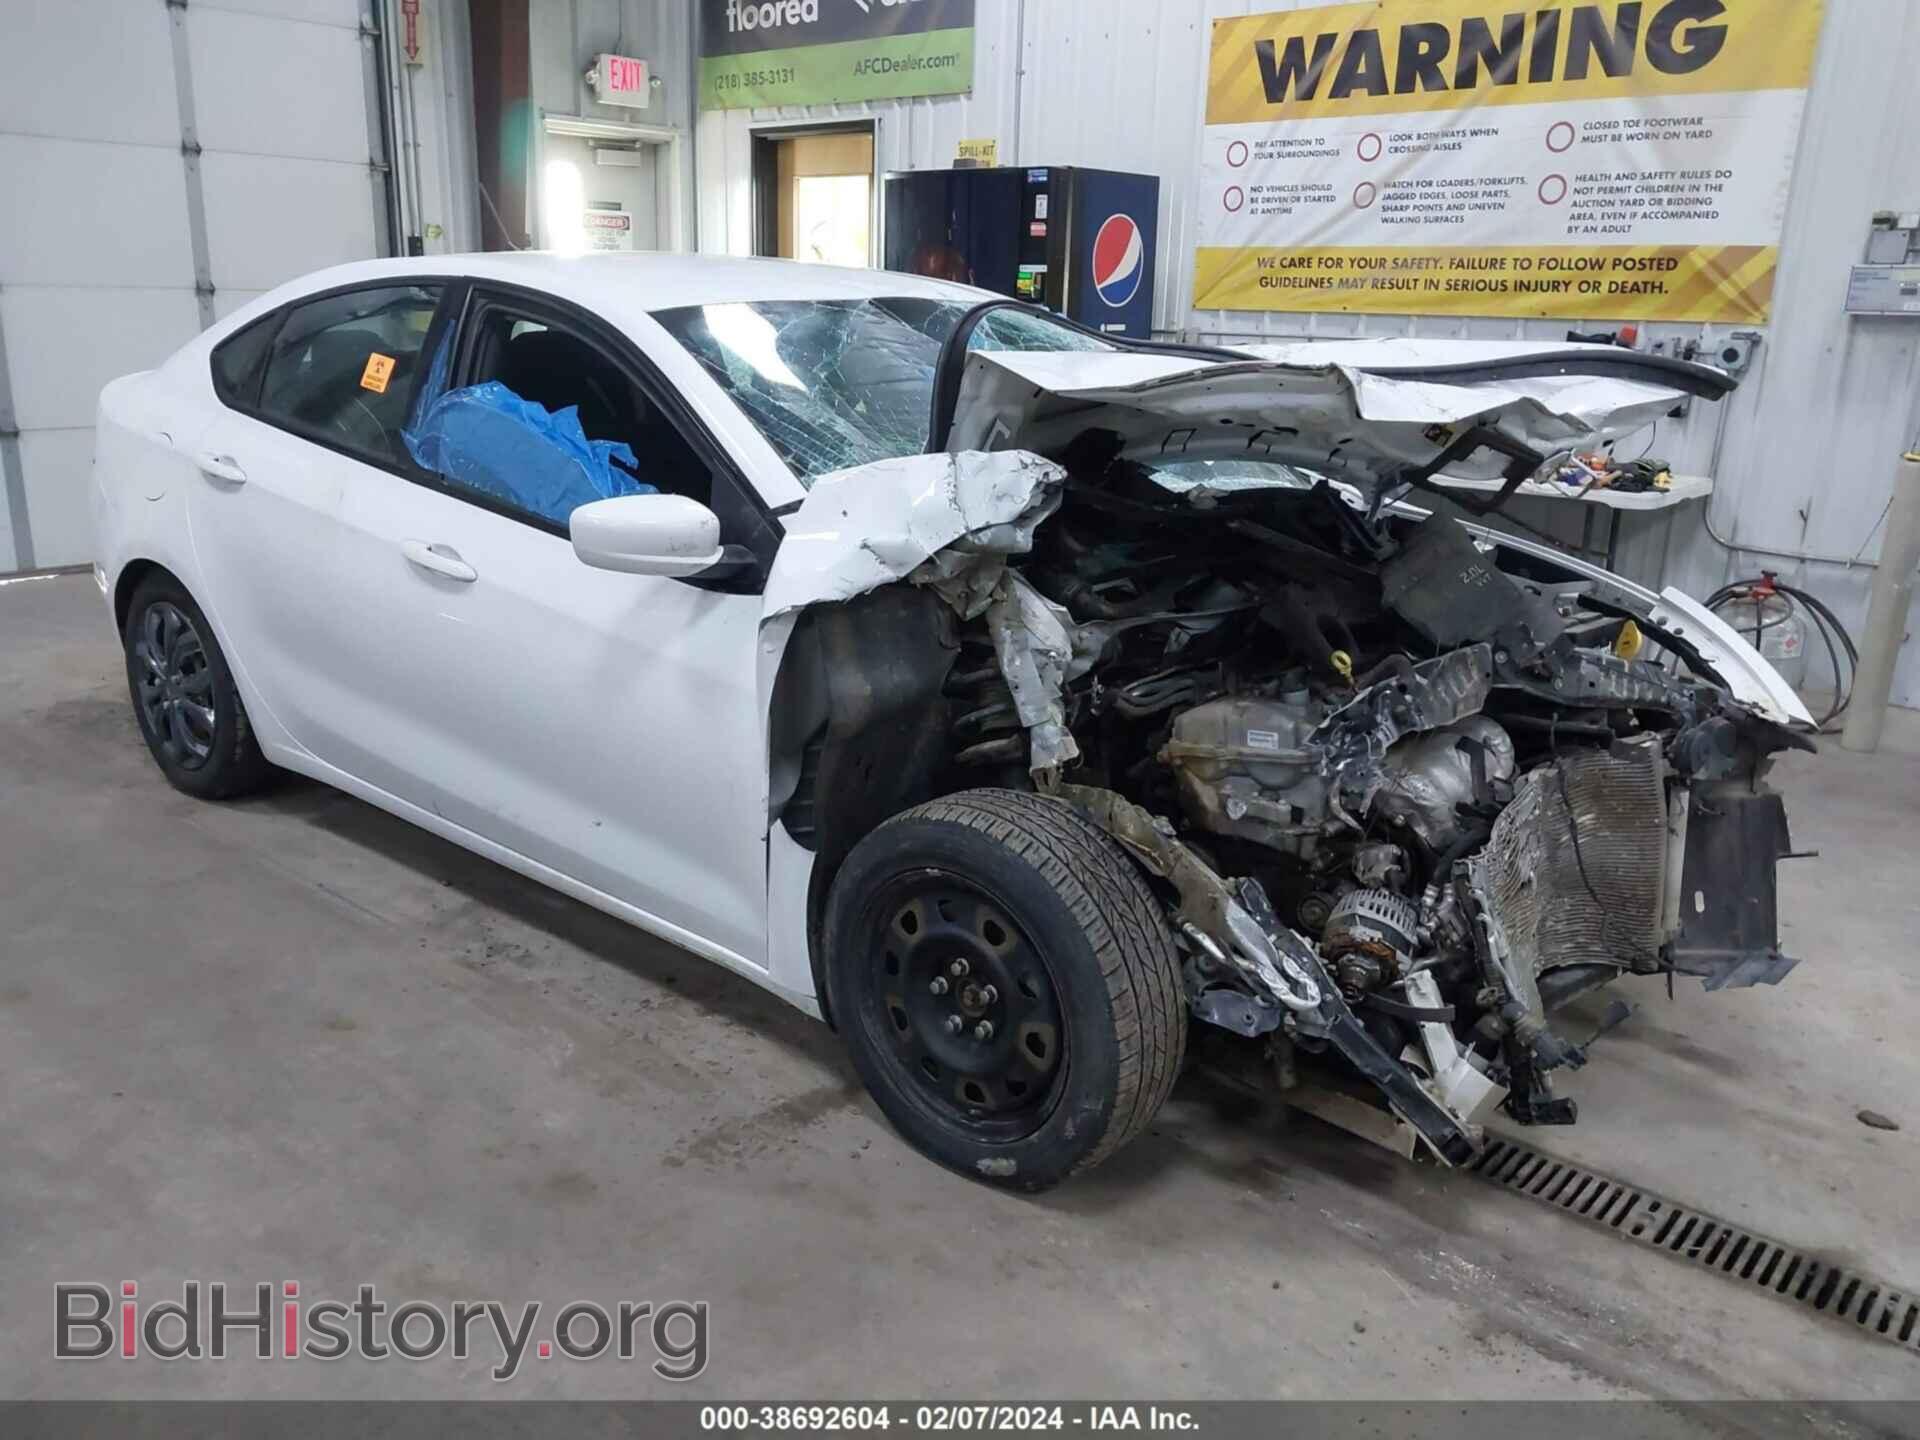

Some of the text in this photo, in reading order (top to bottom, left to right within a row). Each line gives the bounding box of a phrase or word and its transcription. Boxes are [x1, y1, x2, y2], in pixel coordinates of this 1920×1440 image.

[726, 0, 818, 32] floored
[1254, 0, 1729, 104] WARNING
[853, 53, 956, 76] AFCDealer.com
[609, 59, 642, 92] EXIT
[714, 74, 740, 91] (218)
[1583, 117, 1703, 130] CLOSED TOE FOOTWEAR
[1389, 134, 1413, 142] LOOK
[1416, 132, 1439, 141] BOTH
[1470, 128, 1499, 137] WHEN
[1581, 130, 1712, 144] MUST BE WORN ON YARD
[1269, 139, 1312, 147] ATTENTION
[1388, 143, 1462, 154] CROSSING AISLES
[1276, 149, 1340, 159] SURROUNDINGS
[1575, 170, 1732, 182] HEALTH AND SAFETY RULES DO
[1573, 184, 1723, 195] NOT PERMIT CHILDREN IN THE
[1304, 195, 1336, 203] STARTED
[1382, 192, 1416, 200] JAGGED
[1451, 191, 1478, 199] LOOSE
[1446, 203, 1465, 211] AND
[1571, 197, 1712, 208] AUCTION YARD OR BIDDING
[1381, 215, 1464, 224] WALKING SURFACES
[1601, 212, 1626, 220] EVEN
[1629, 211, 1638, 219] IF
[1641, 210, 1719, 219] ACCOMPANIED
[1567, 225, 1632, 233] BY AN ADULT
[1257, 257, 1679, 271] WE CARE FOR YOUR SAFETY. FAILURE TO FOLLOW POSTED
[1259, 276, 1669, 294] GUIDELINES MAY RESULT IN SERIOUS INJURY OR DEATH.
